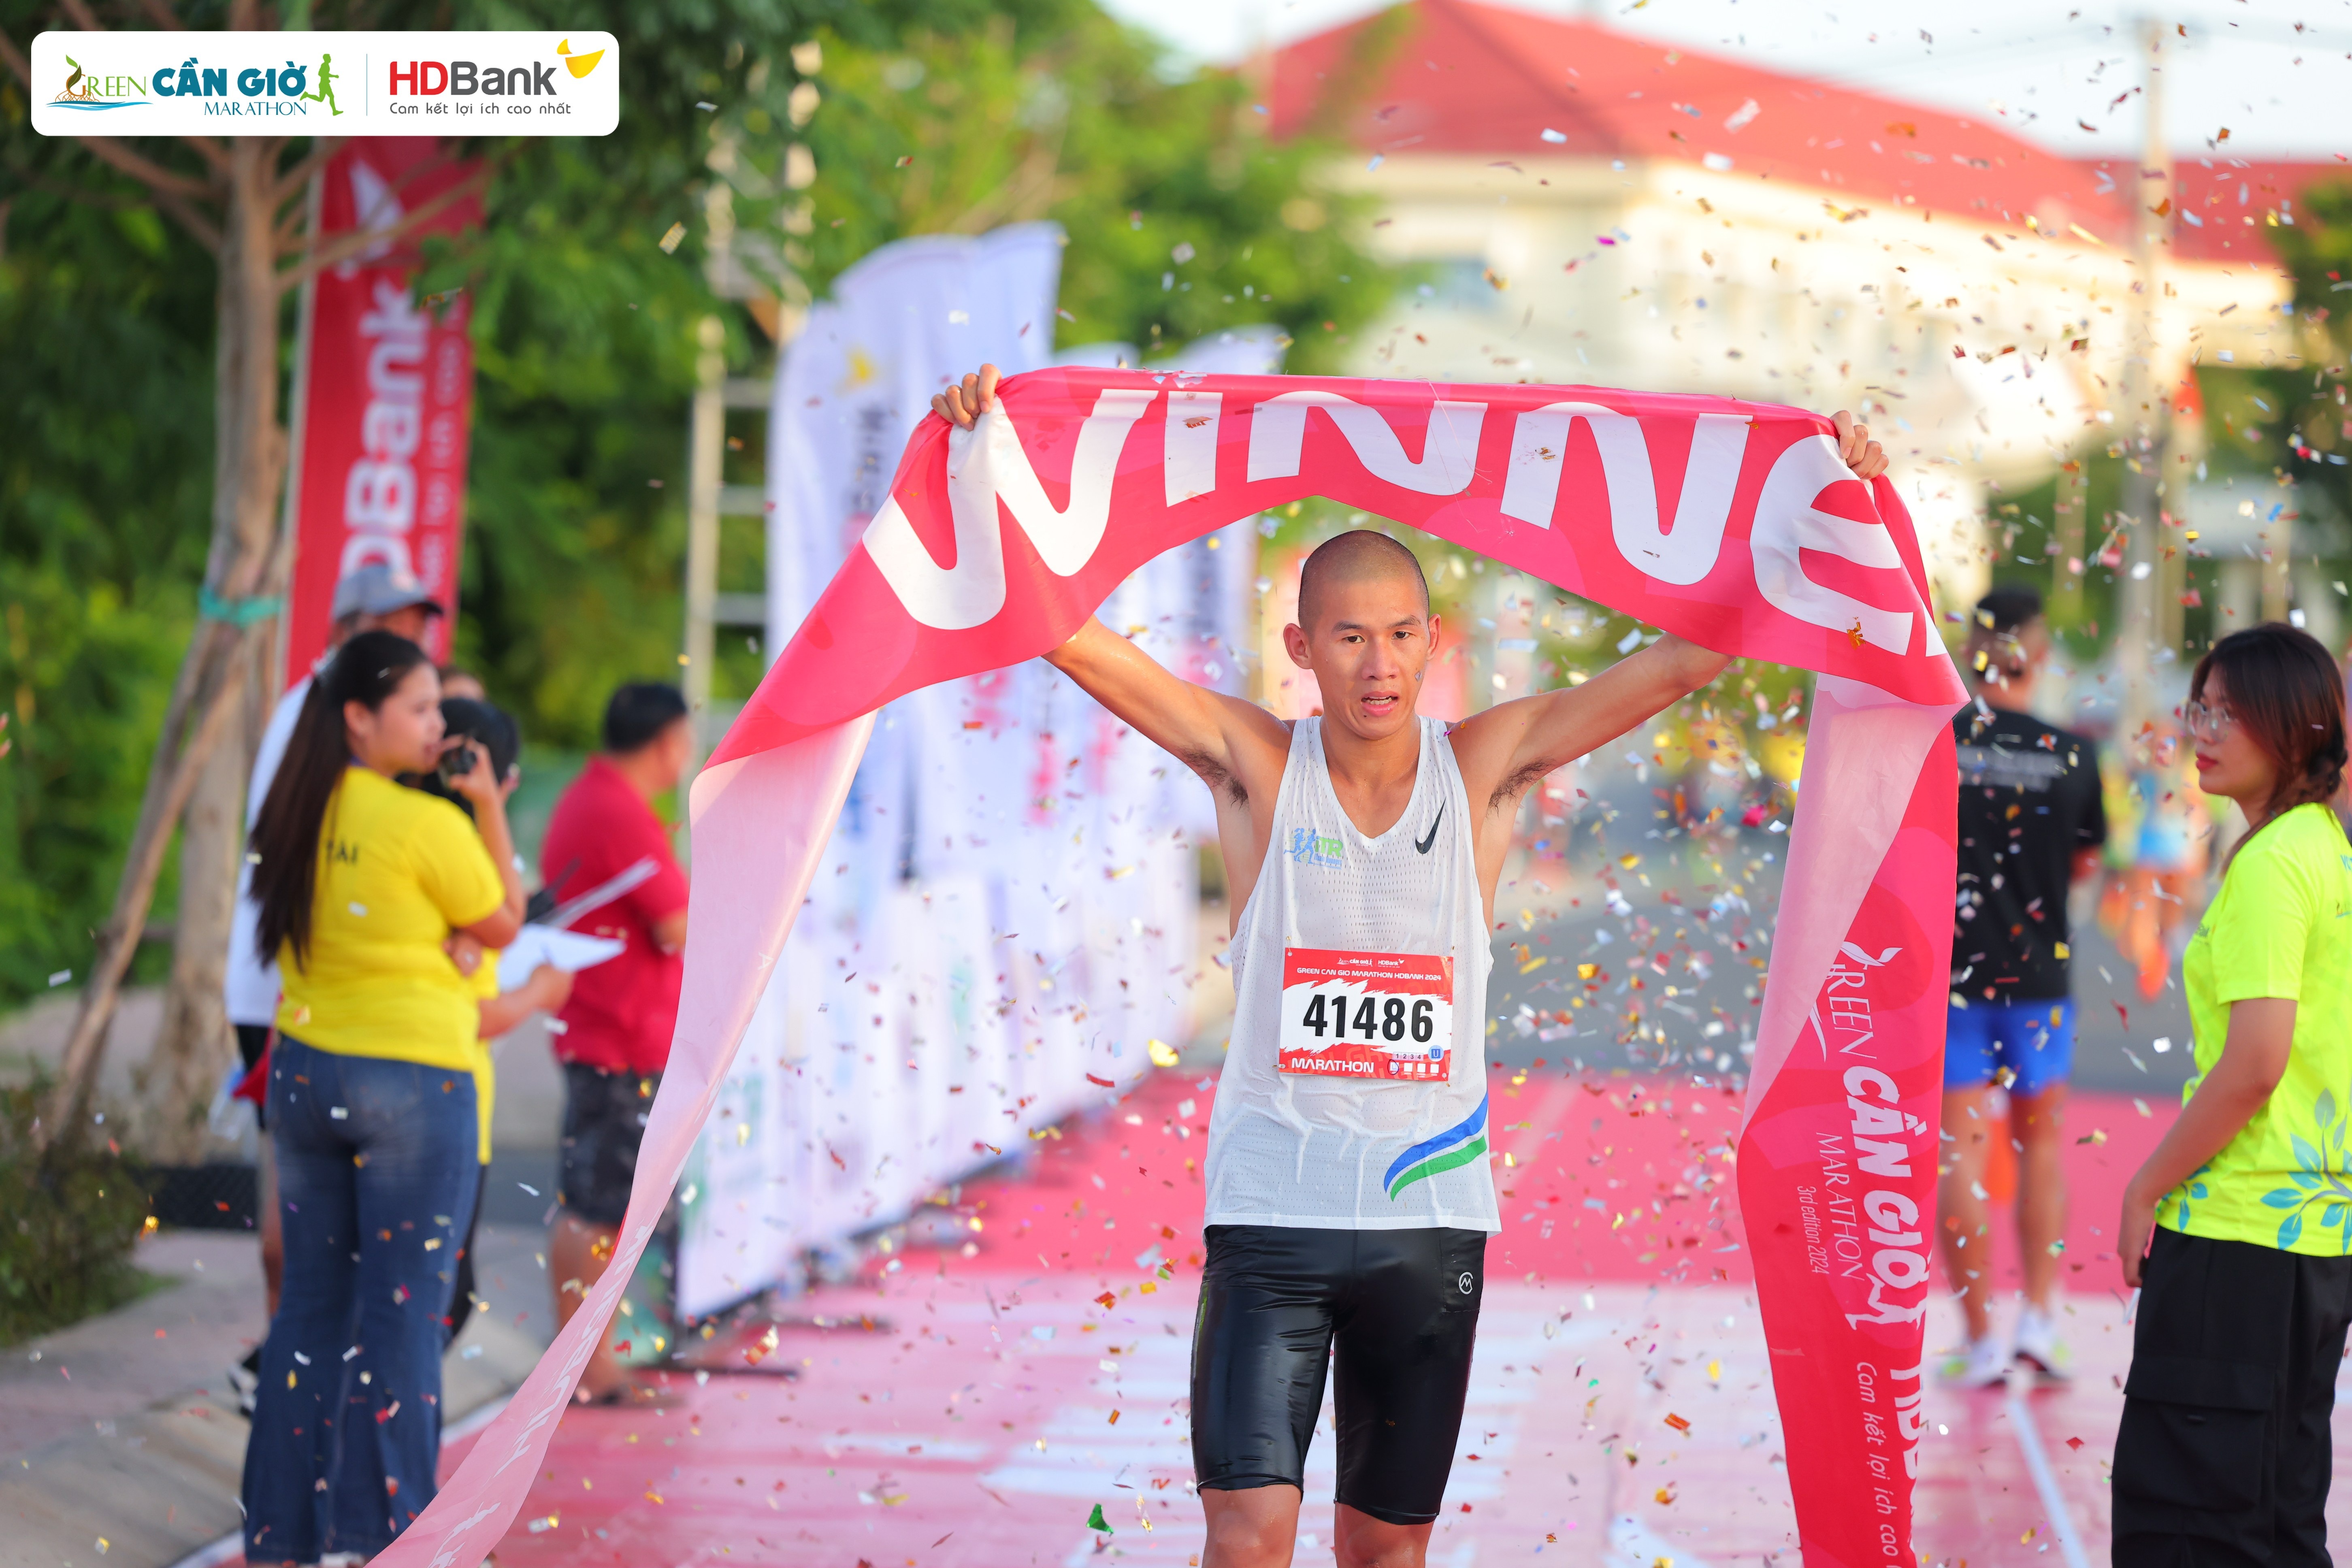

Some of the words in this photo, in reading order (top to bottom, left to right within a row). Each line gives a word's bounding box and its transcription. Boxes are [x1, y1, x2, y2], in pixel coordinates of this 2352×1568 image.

[339, 279, 429, 581] DBank
[1303, 994, 1433, 1042] 41486
[1291, 1057, 1374, 1073] MARATHON
[1843, 1065, 1927, 1178] CẦN
[1797, 1186, 1818, 1205] 3rd
[1816, 1132, 1865, 1281] MARATHON
[1801, 1206, 1822, 1244] edition
[1808, 1247, 1830, 1274] 2024
[1857, 1362, 1877, 1403] Cam
[1863, 1412, 1887, 1446] kết
[1866, 1453, 1890, 1481] lợi
[1874, 1487, 1898, 1515] ích
[1880, 1524, 1899, 1557] cao
